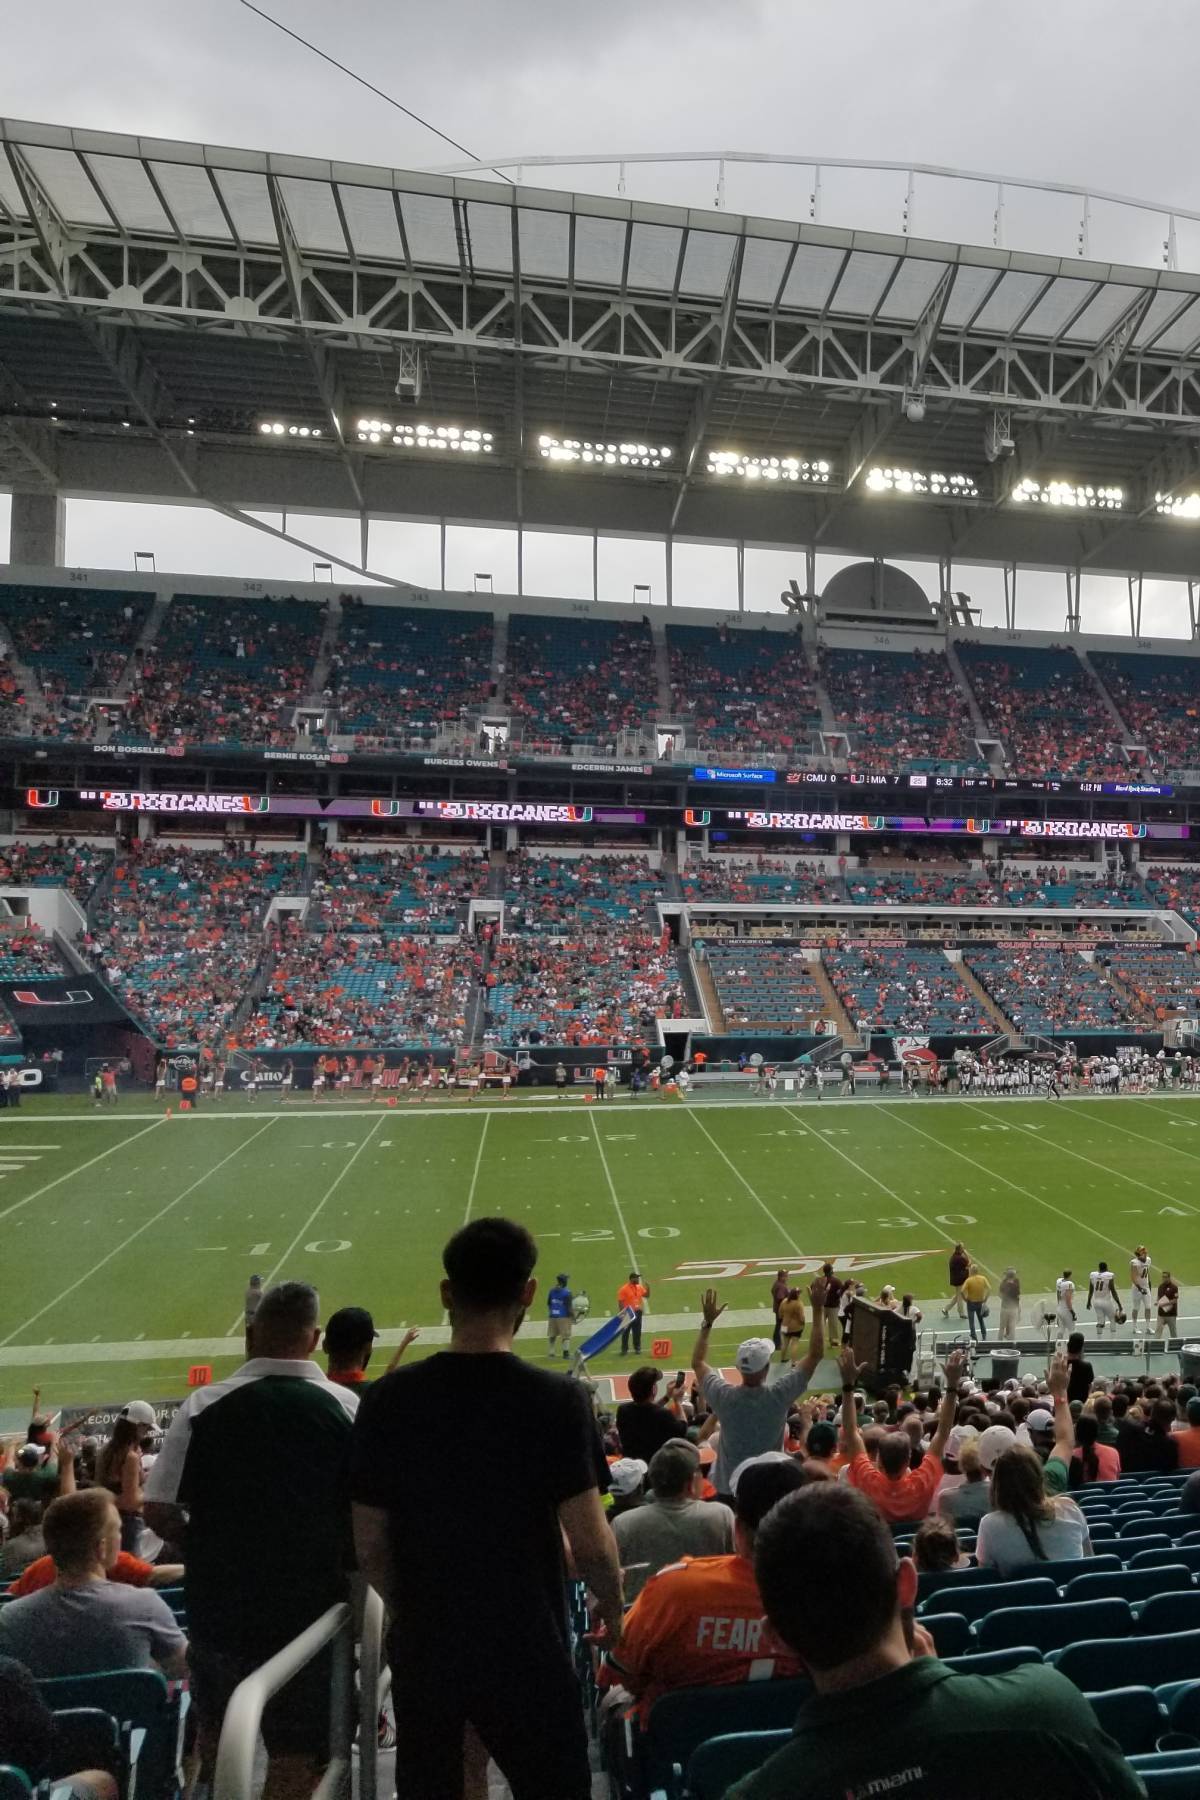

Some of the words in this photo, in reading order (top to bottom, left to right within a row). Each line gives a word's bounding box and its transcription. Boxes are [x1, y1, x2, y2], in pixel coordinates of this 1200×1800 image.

[70, 572, 88, 582] 341
[243, 583, 263, 592] 342
[874, 636, 890, 645] 346
[117, 746, 165, 755] BOSSELER
[264, 752, 297, 760] BERNIE
[424, 758, 463, 766] BURGESS
[466, 760, 499, 768] OWENS
[717, 770, 741, 779] Microsoft
[807, 773, 827, 782] CMU
[871, 775, 887, 784] MIA
[894, 776, 899, 784] 7
[876, 1213, 978, 1229] 30
[571, 1225, 681, 1243] 20
[248, 1239, 354, 1256] 10
[696, 1616, 763, 1653] FEAR
